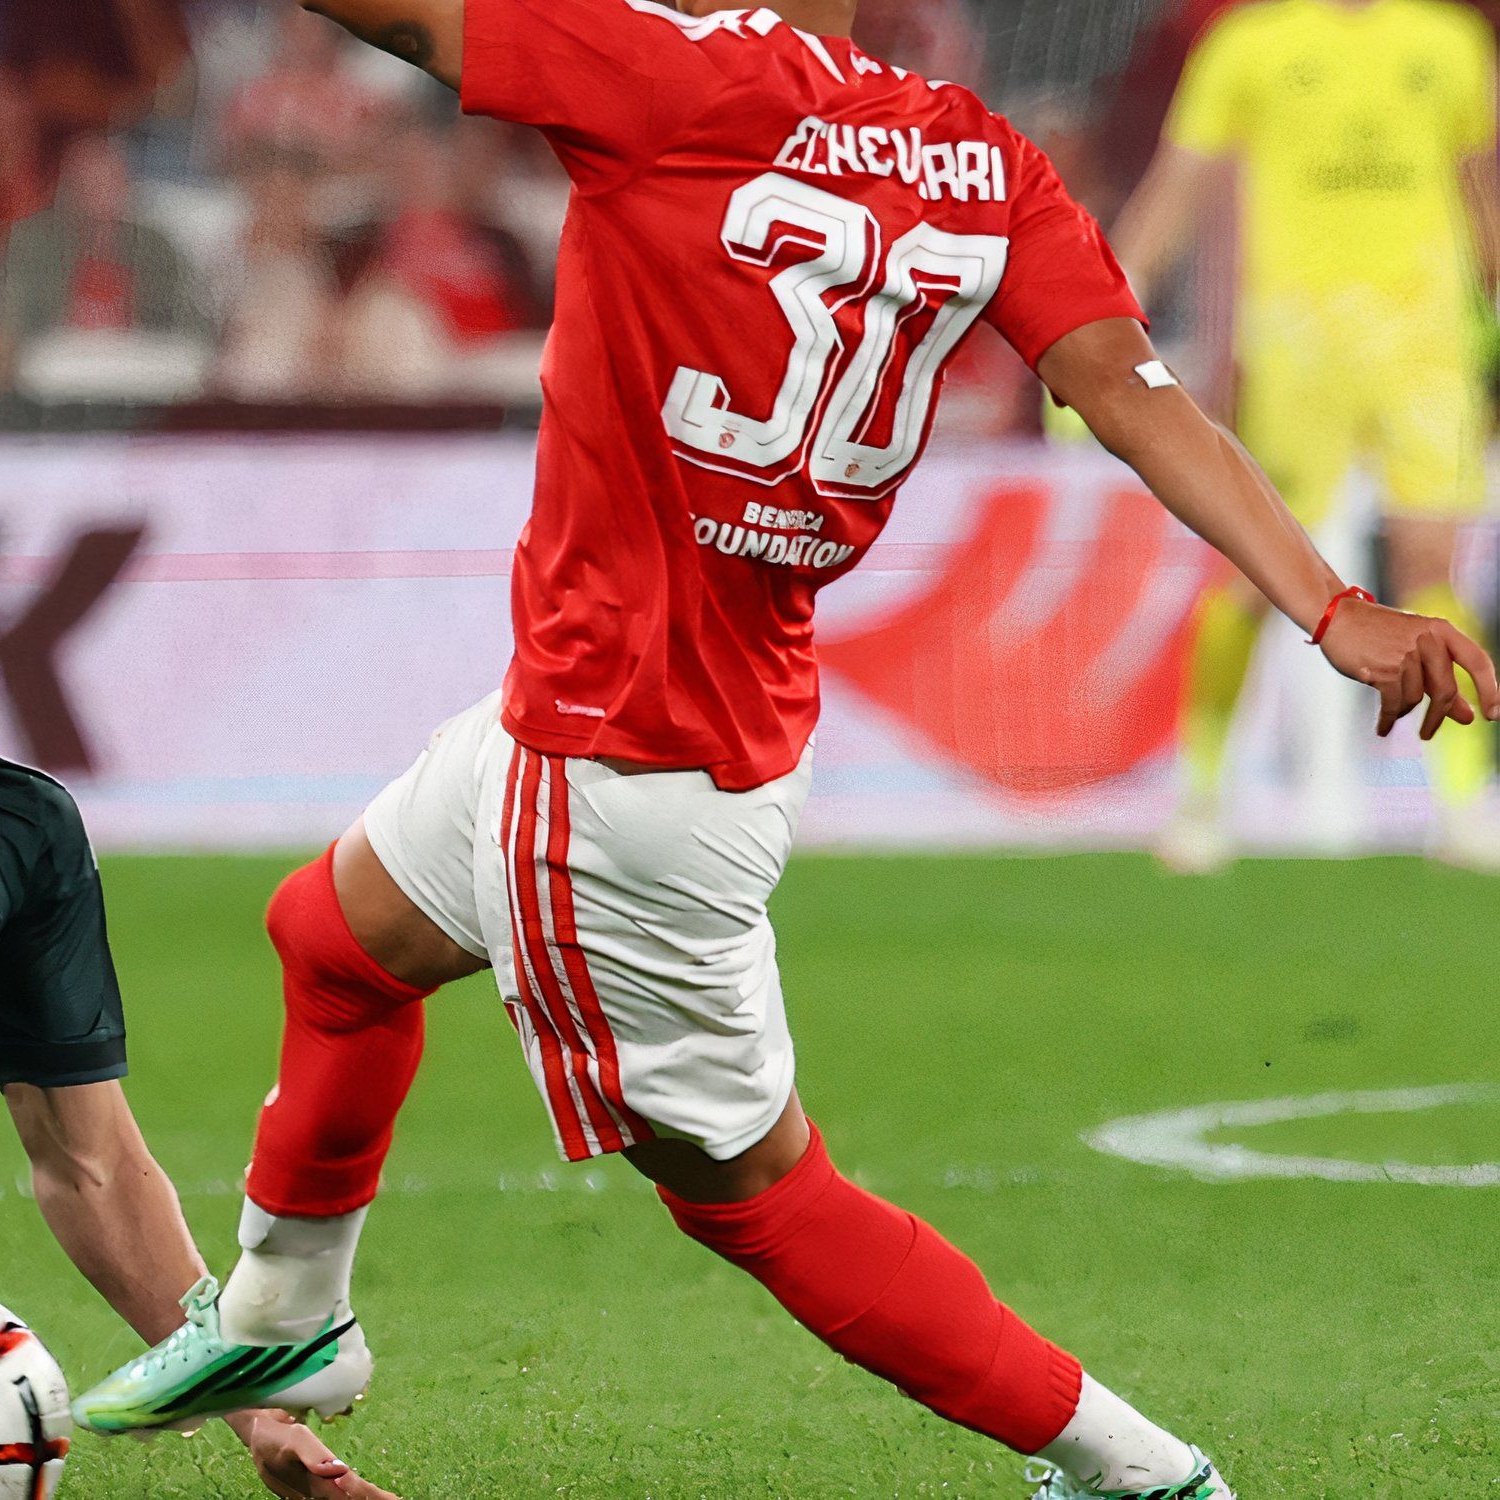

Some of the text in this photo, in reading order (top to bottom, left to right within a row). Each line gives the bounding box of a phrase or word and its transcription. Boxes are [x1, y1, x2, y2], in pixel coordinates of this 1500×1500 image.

[772, 115, 1007, 202] ECHEVRRI
[660, 171, 1010, 501] 30
[687, 511, 856, 569] OUNDATION
